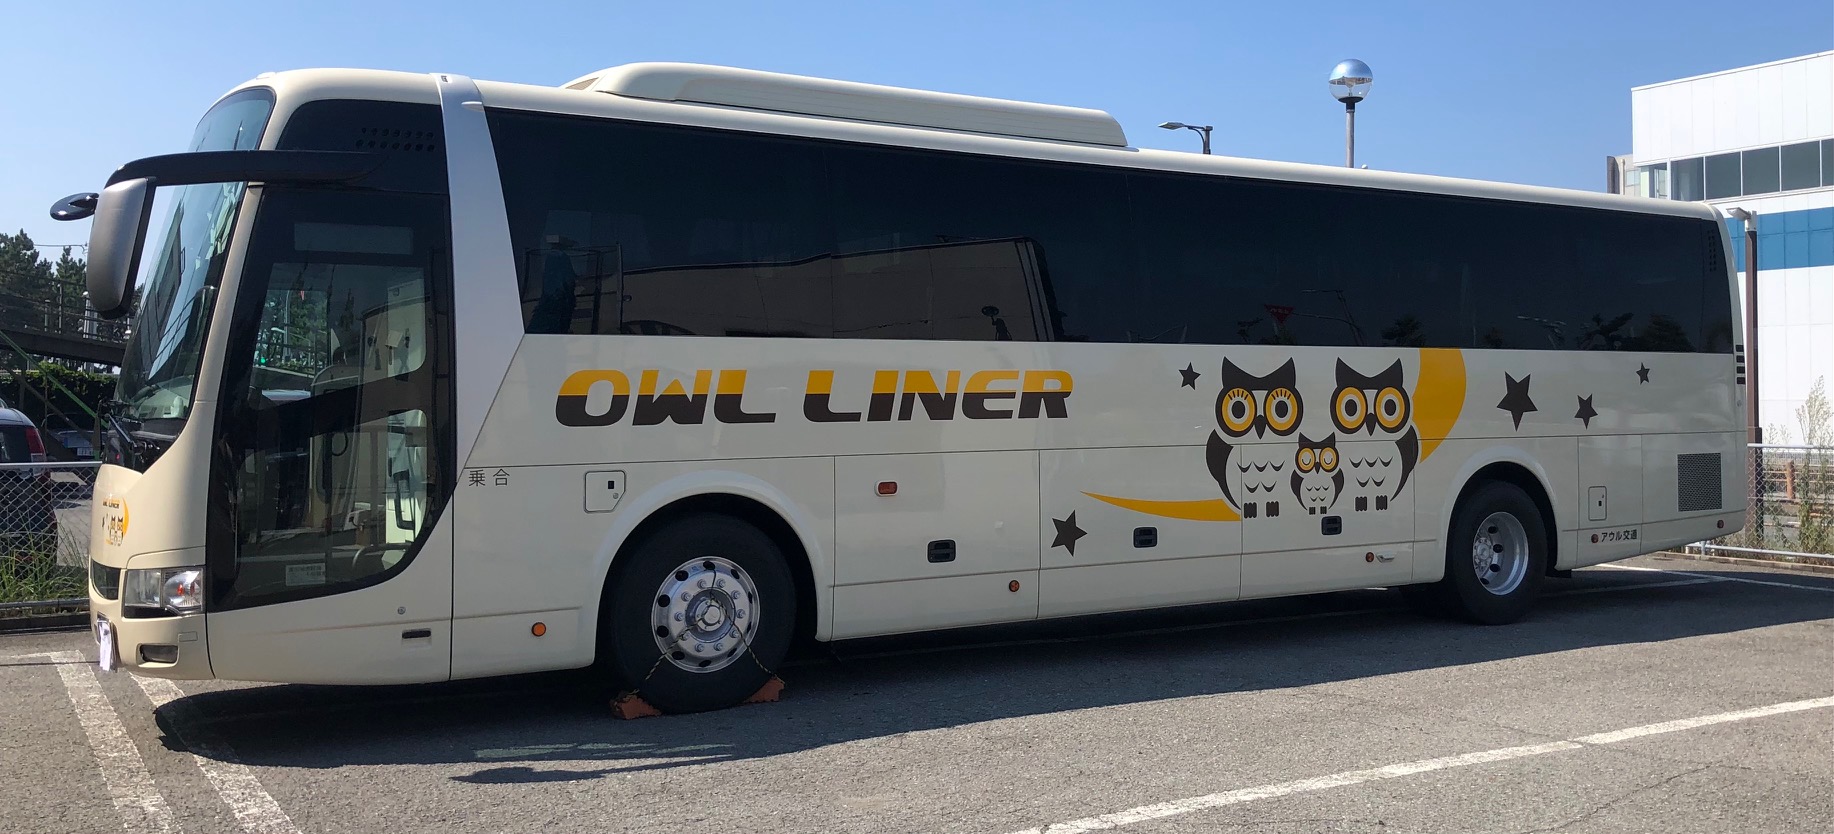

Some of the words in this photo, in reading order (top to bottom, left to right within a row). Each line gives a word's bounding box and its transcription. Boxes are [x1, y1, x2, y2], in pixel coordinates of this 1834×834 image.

[555, 369, 777, 427] OWL
[803, 369, 1074, 423] LINER
[469, 468, 510, 487] 乗合
[1601, 529, 1637, 542] アウル交通
